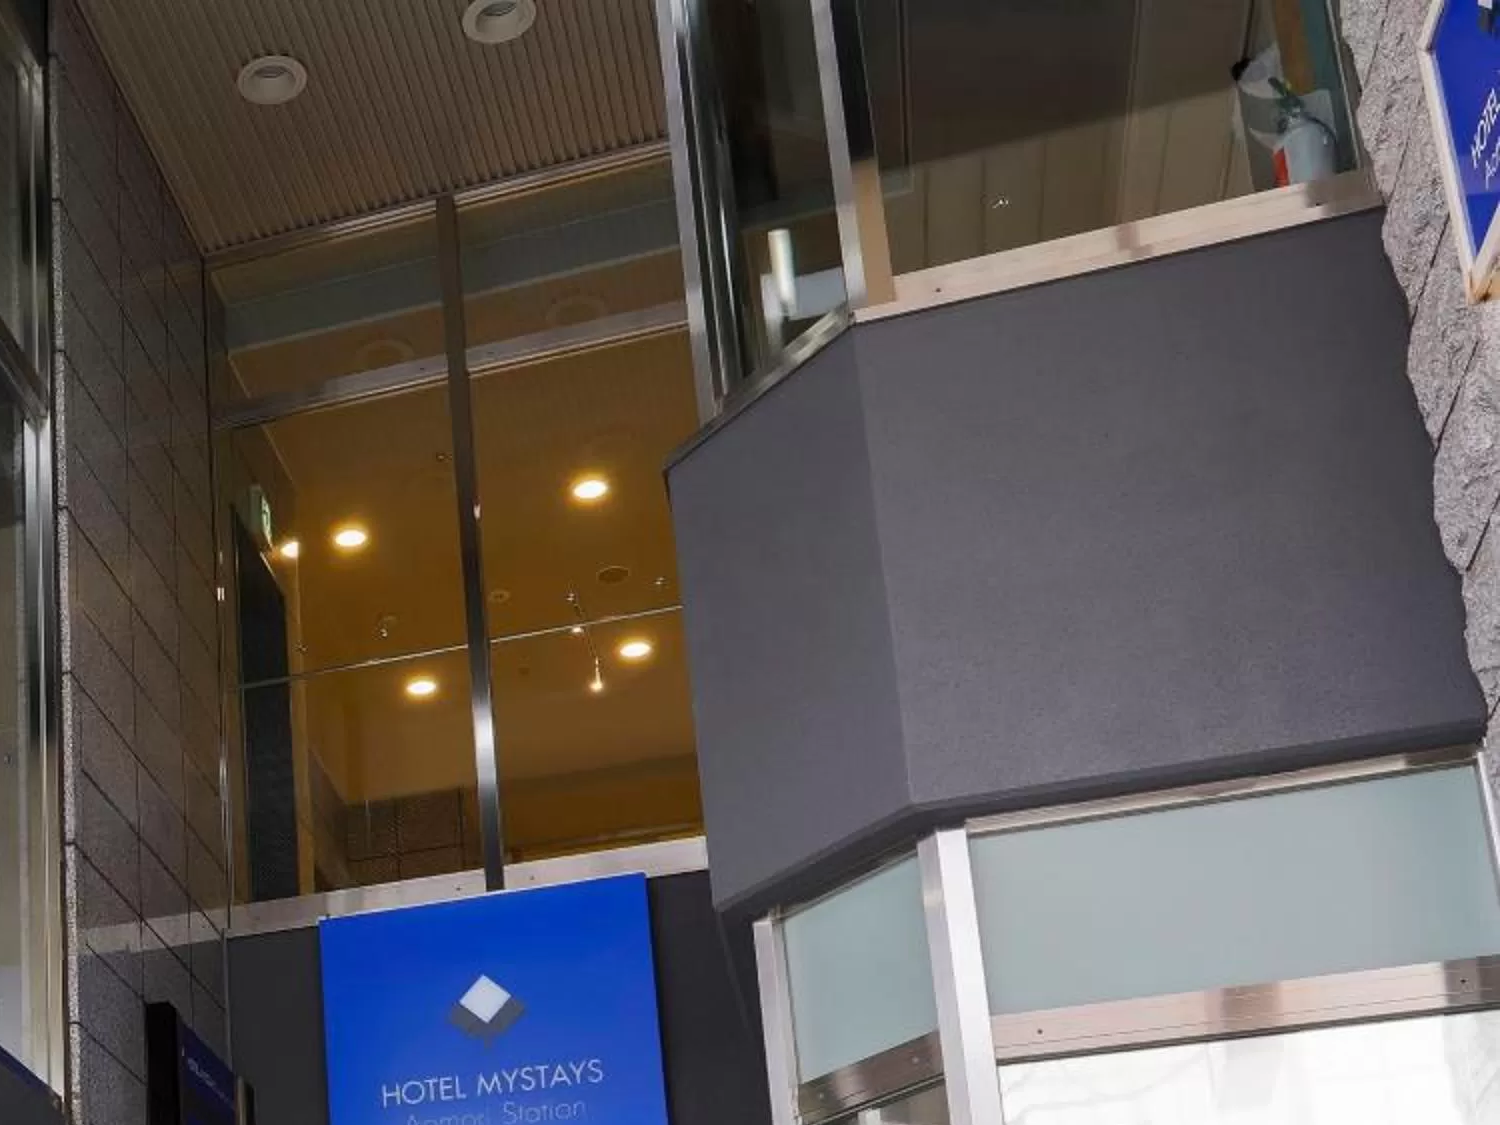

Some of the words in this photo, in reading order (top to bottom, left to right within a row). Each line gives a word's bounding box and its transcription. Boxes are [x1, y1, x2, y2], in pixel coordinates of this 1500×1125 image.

[381, 1076, 467, 1108] HOTEL
[477, 1059, 604, 1097] MYSTAYS
[503, 1101, 586, 1125] Station
